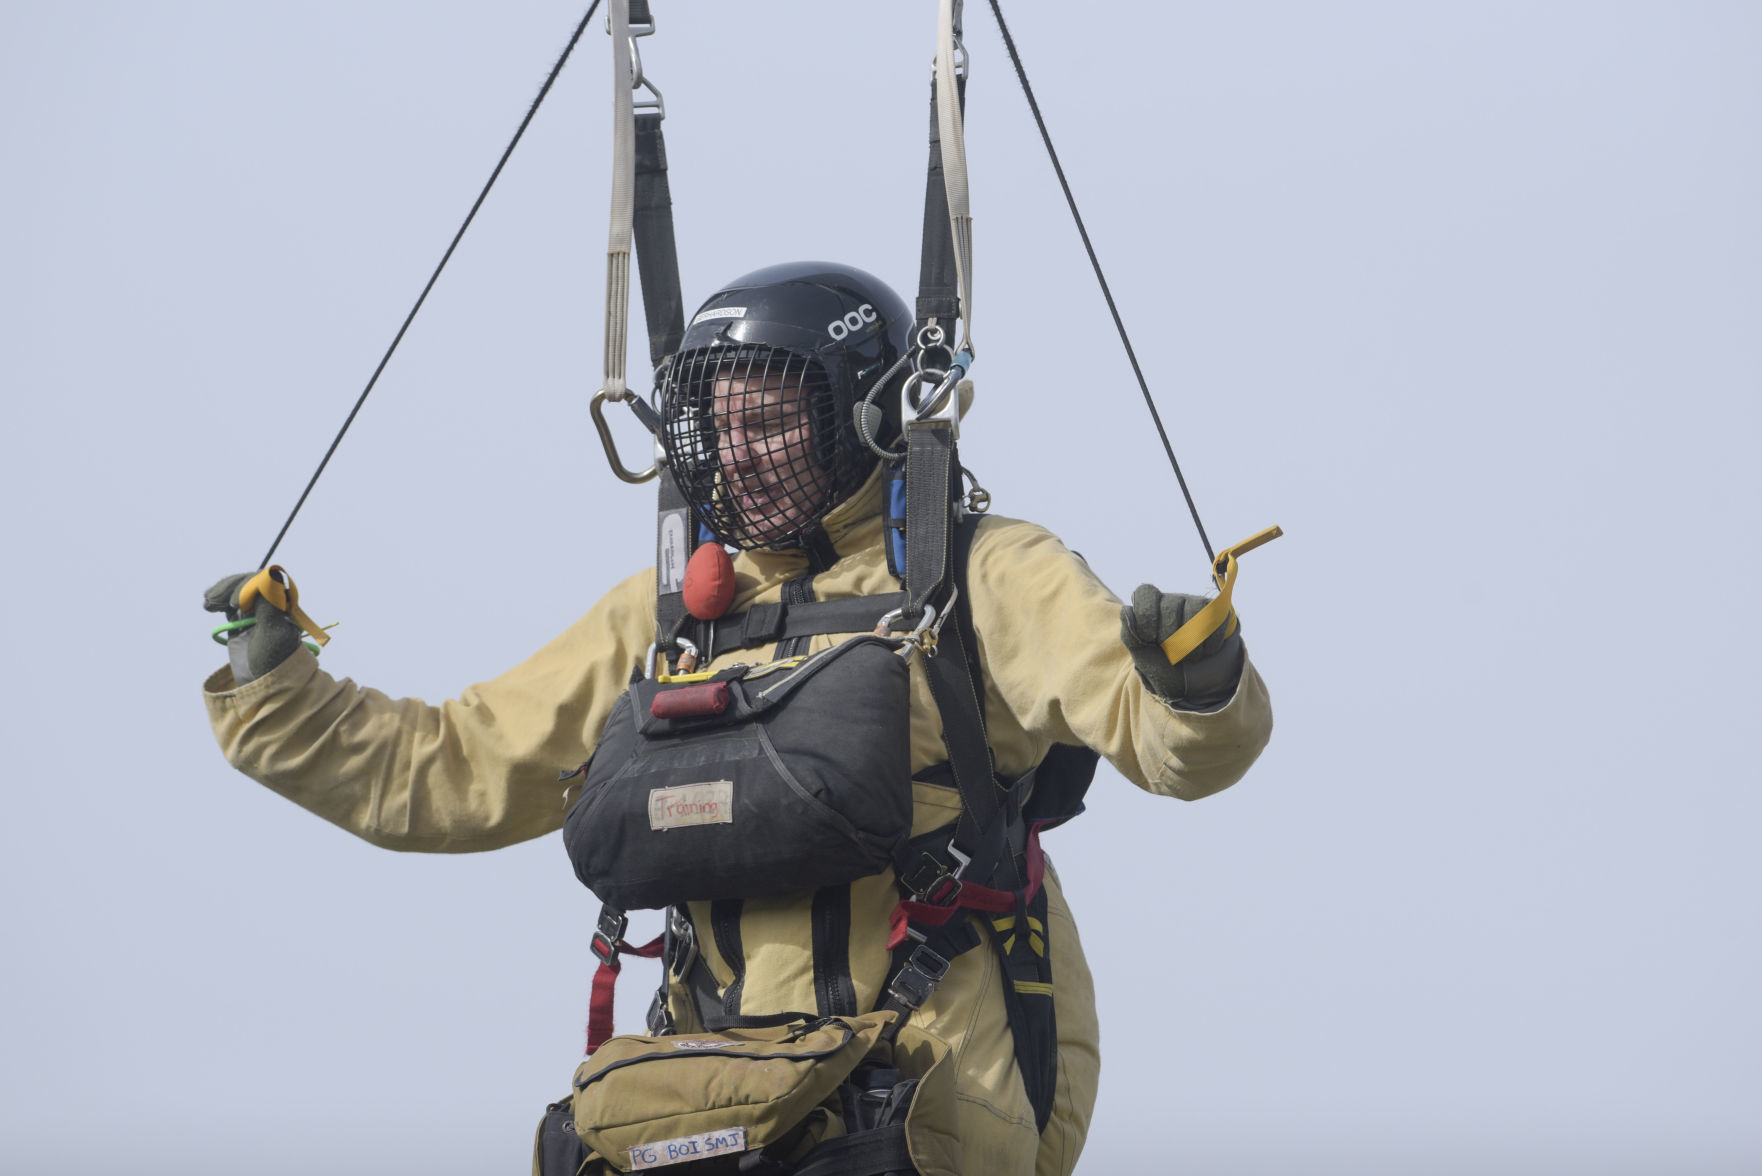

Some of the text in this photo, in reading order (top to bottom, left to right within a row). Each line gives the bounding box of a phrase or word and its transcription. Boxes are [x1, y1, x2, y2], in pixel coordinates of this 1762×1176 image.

[655, 794, 719, 821] Training
[631, 1132, 740, 1166] PG BOI SMJ
